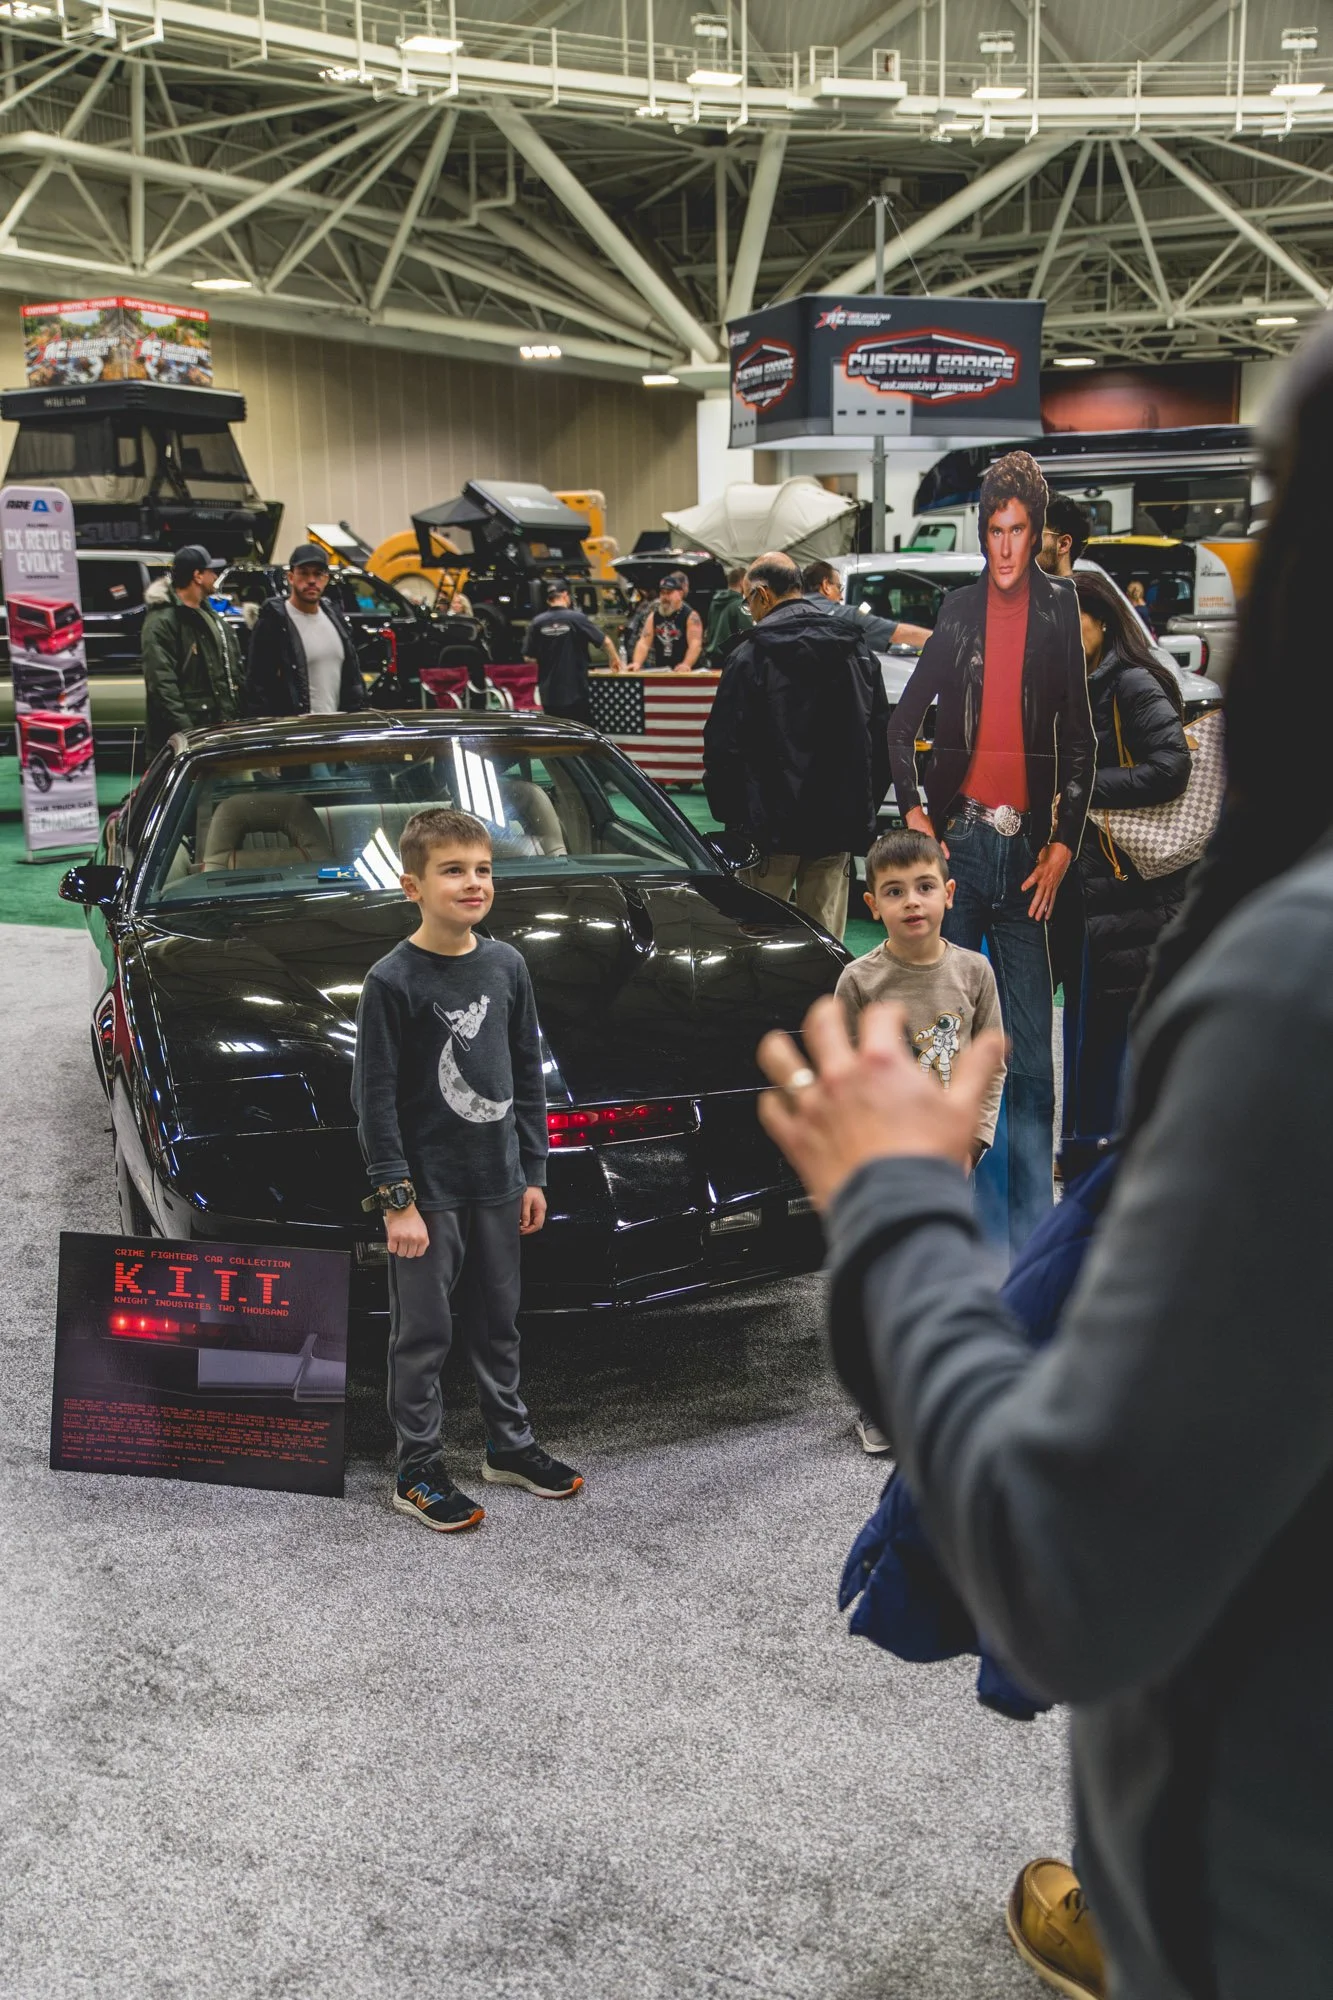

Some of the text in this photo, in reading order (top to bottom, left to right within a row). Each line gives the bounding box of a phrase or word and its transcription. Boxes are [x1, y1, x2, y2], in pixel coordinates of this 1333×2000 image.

[847, 353, 1016, 379] CUSTOM GARAGE
[4, 529, 24, 551] CX
[25, 529, 60, 551] REVO
[16, 551, 65, 573] EVOLVE
[114, 1248, 291, 1268] CRIME FIGHTERS CAR COLLECTION
[114, 1262, 290, 1306] K.I.T.T.
[114, 1295, 289, 1317] KNIGHT INDUSTRIES TWO THOUSAND
